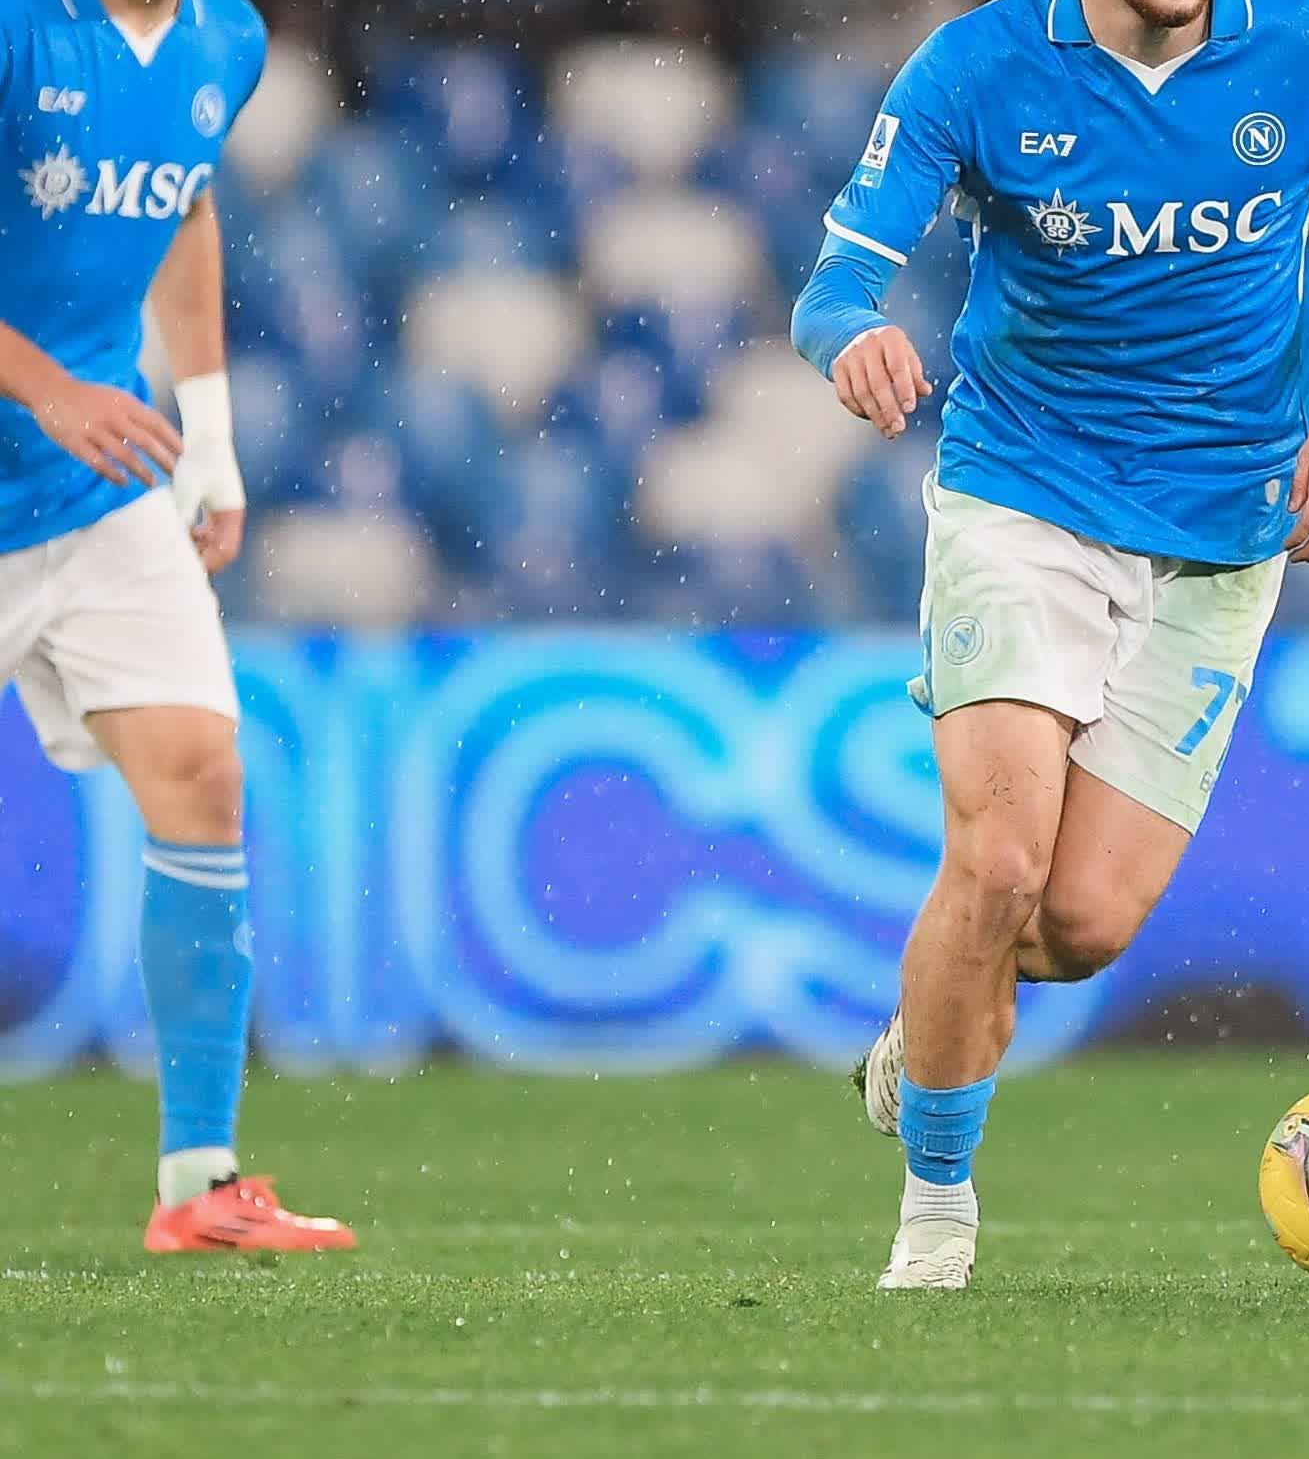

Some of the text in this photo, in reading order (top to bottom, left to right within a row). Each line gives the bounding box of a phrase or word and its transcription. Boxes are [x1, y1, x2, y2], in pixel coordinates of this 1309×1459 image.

[1020, 131, 1078, 157] EA7
[1247, 126, 1272, 152] N
[1105, 189, 1283, 257] MSC
